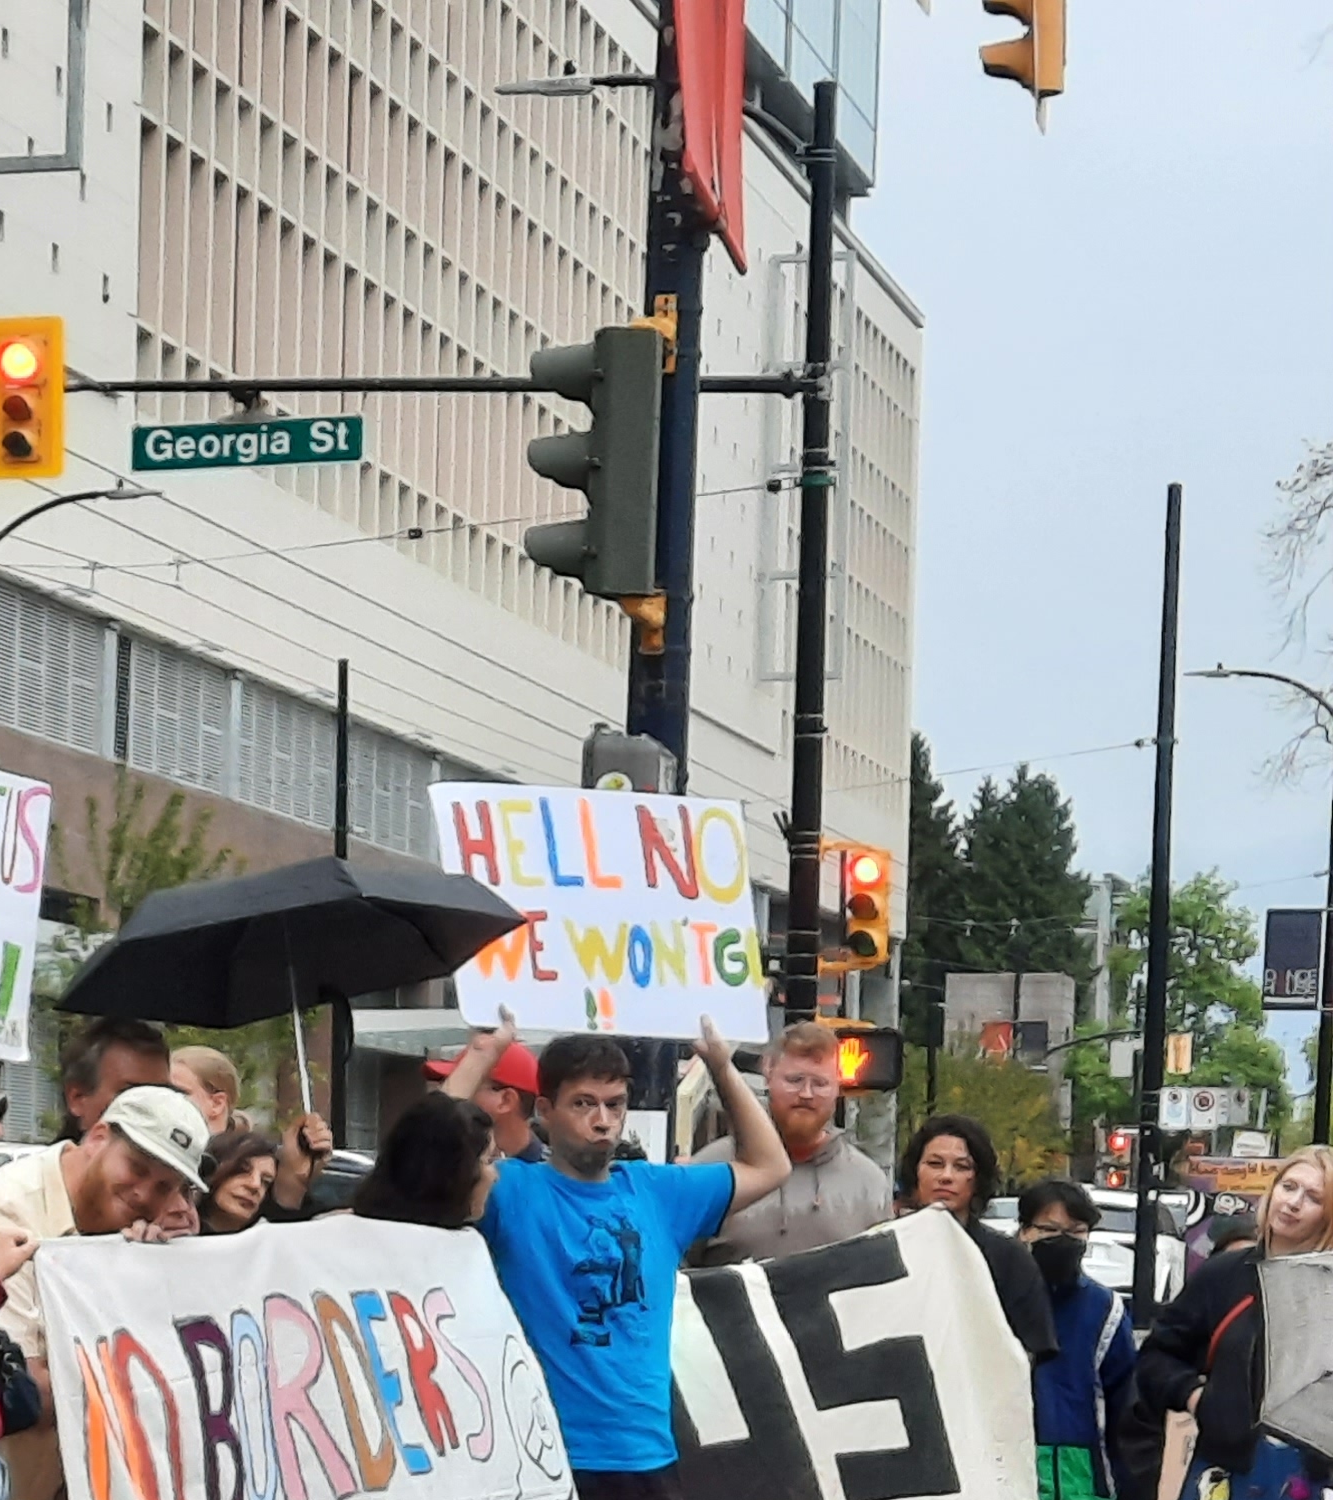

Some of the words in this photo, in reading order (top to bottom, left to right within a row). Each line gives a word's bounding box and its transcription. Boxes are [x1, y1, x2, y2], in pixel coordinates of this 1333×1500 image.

[145, 425, 291, 463] Georgia
[309, 420, 349, 453] St
[452, 797, 623, 887] HELL
[636, 803, 746, 904] NO
[473, 911, 559, 982] WE
